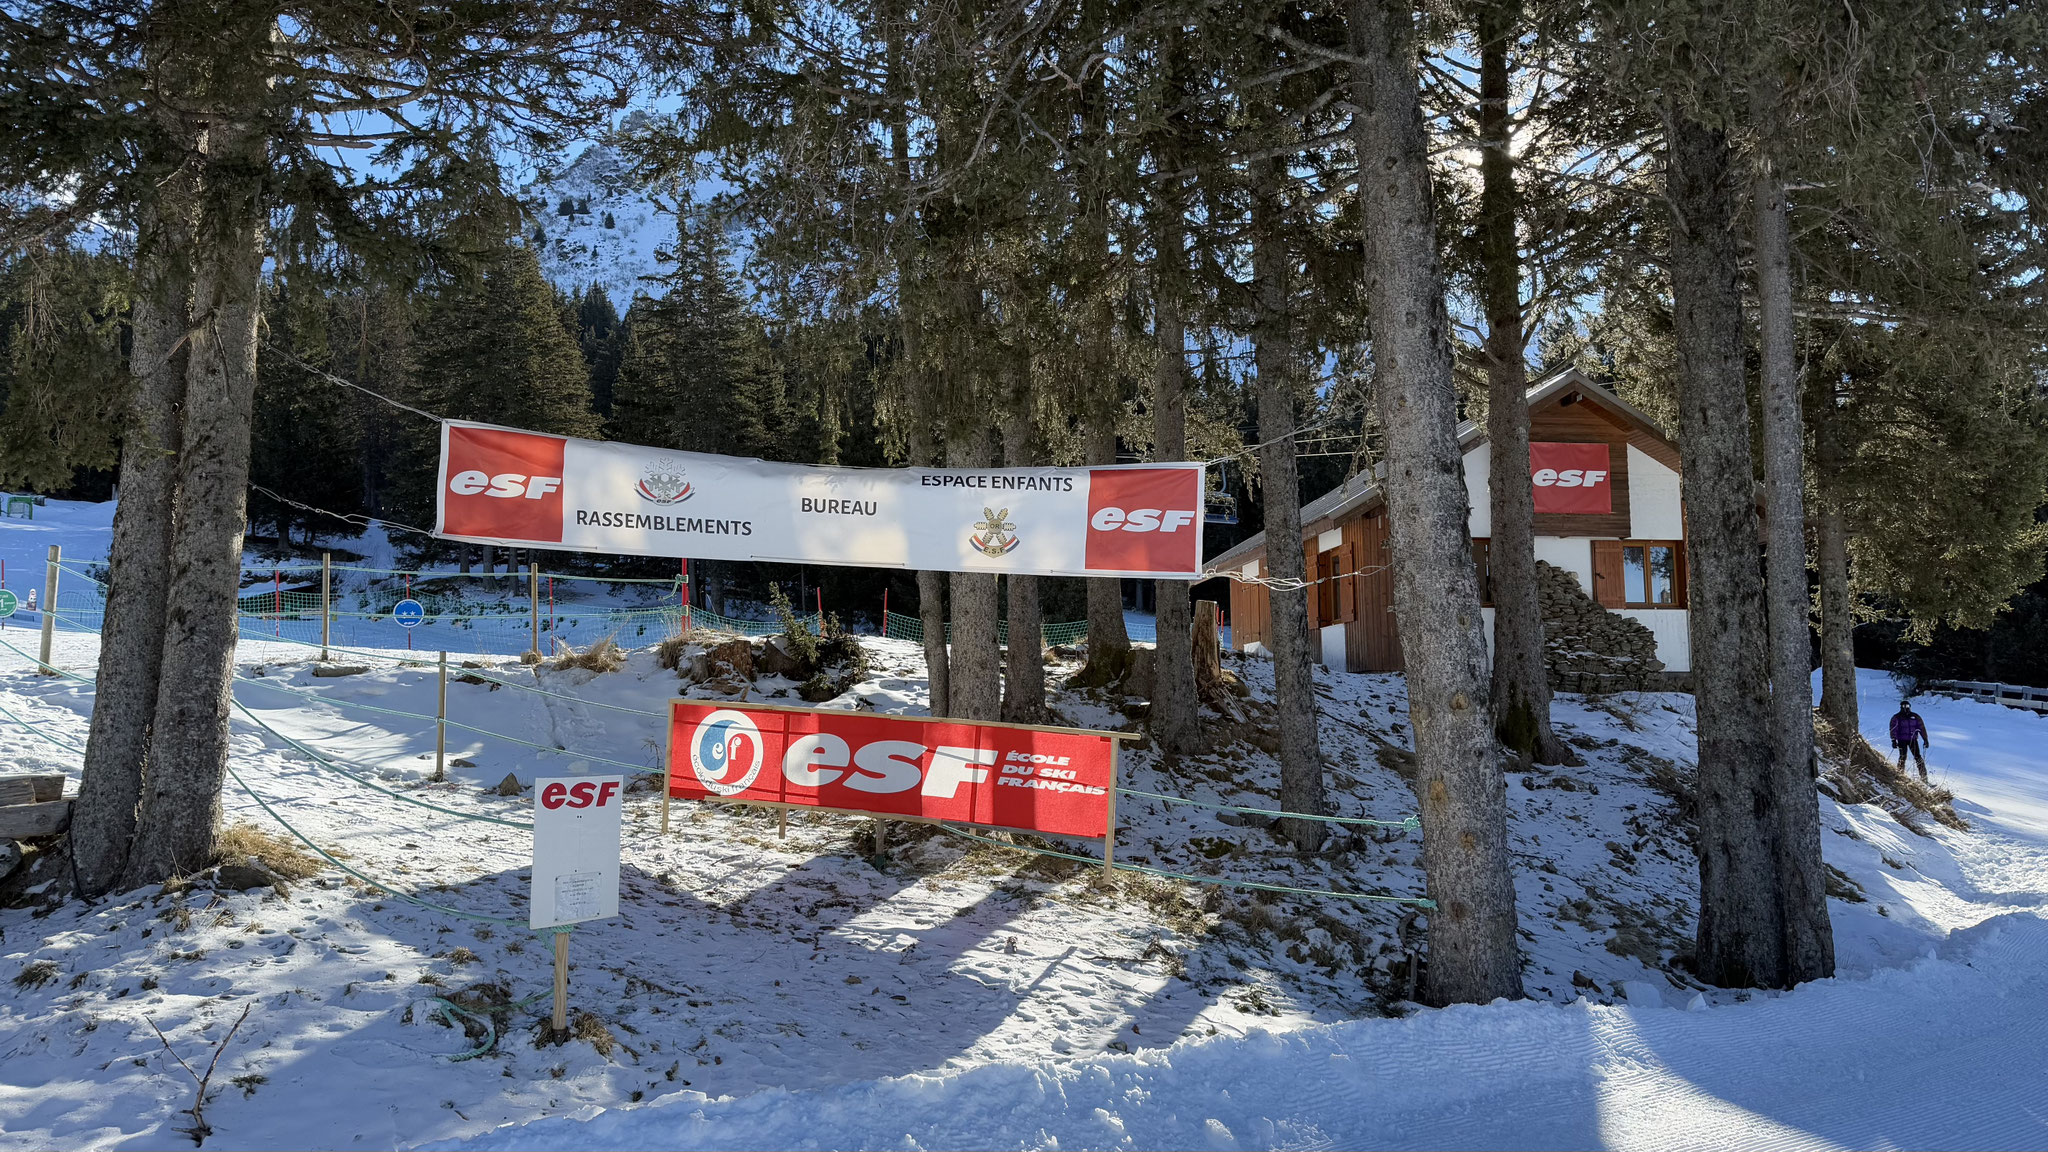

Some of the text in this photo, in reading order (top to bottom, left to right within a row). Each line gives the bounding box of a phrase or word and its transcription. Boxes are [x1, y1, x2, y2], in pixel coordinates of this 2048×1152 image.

[921, 475, 1073, 492] ESPACE ENFANTS
[801, 497, 878, 516] BUREAU
[576, 509, 752, 536] RASSEMBLEMENTS
[1005, 750, 1071, 766] ÉCOLE
[1001, 764, 1077, 780] DU SKI
[997, 776, 1106, 796] FRANÇAIS
